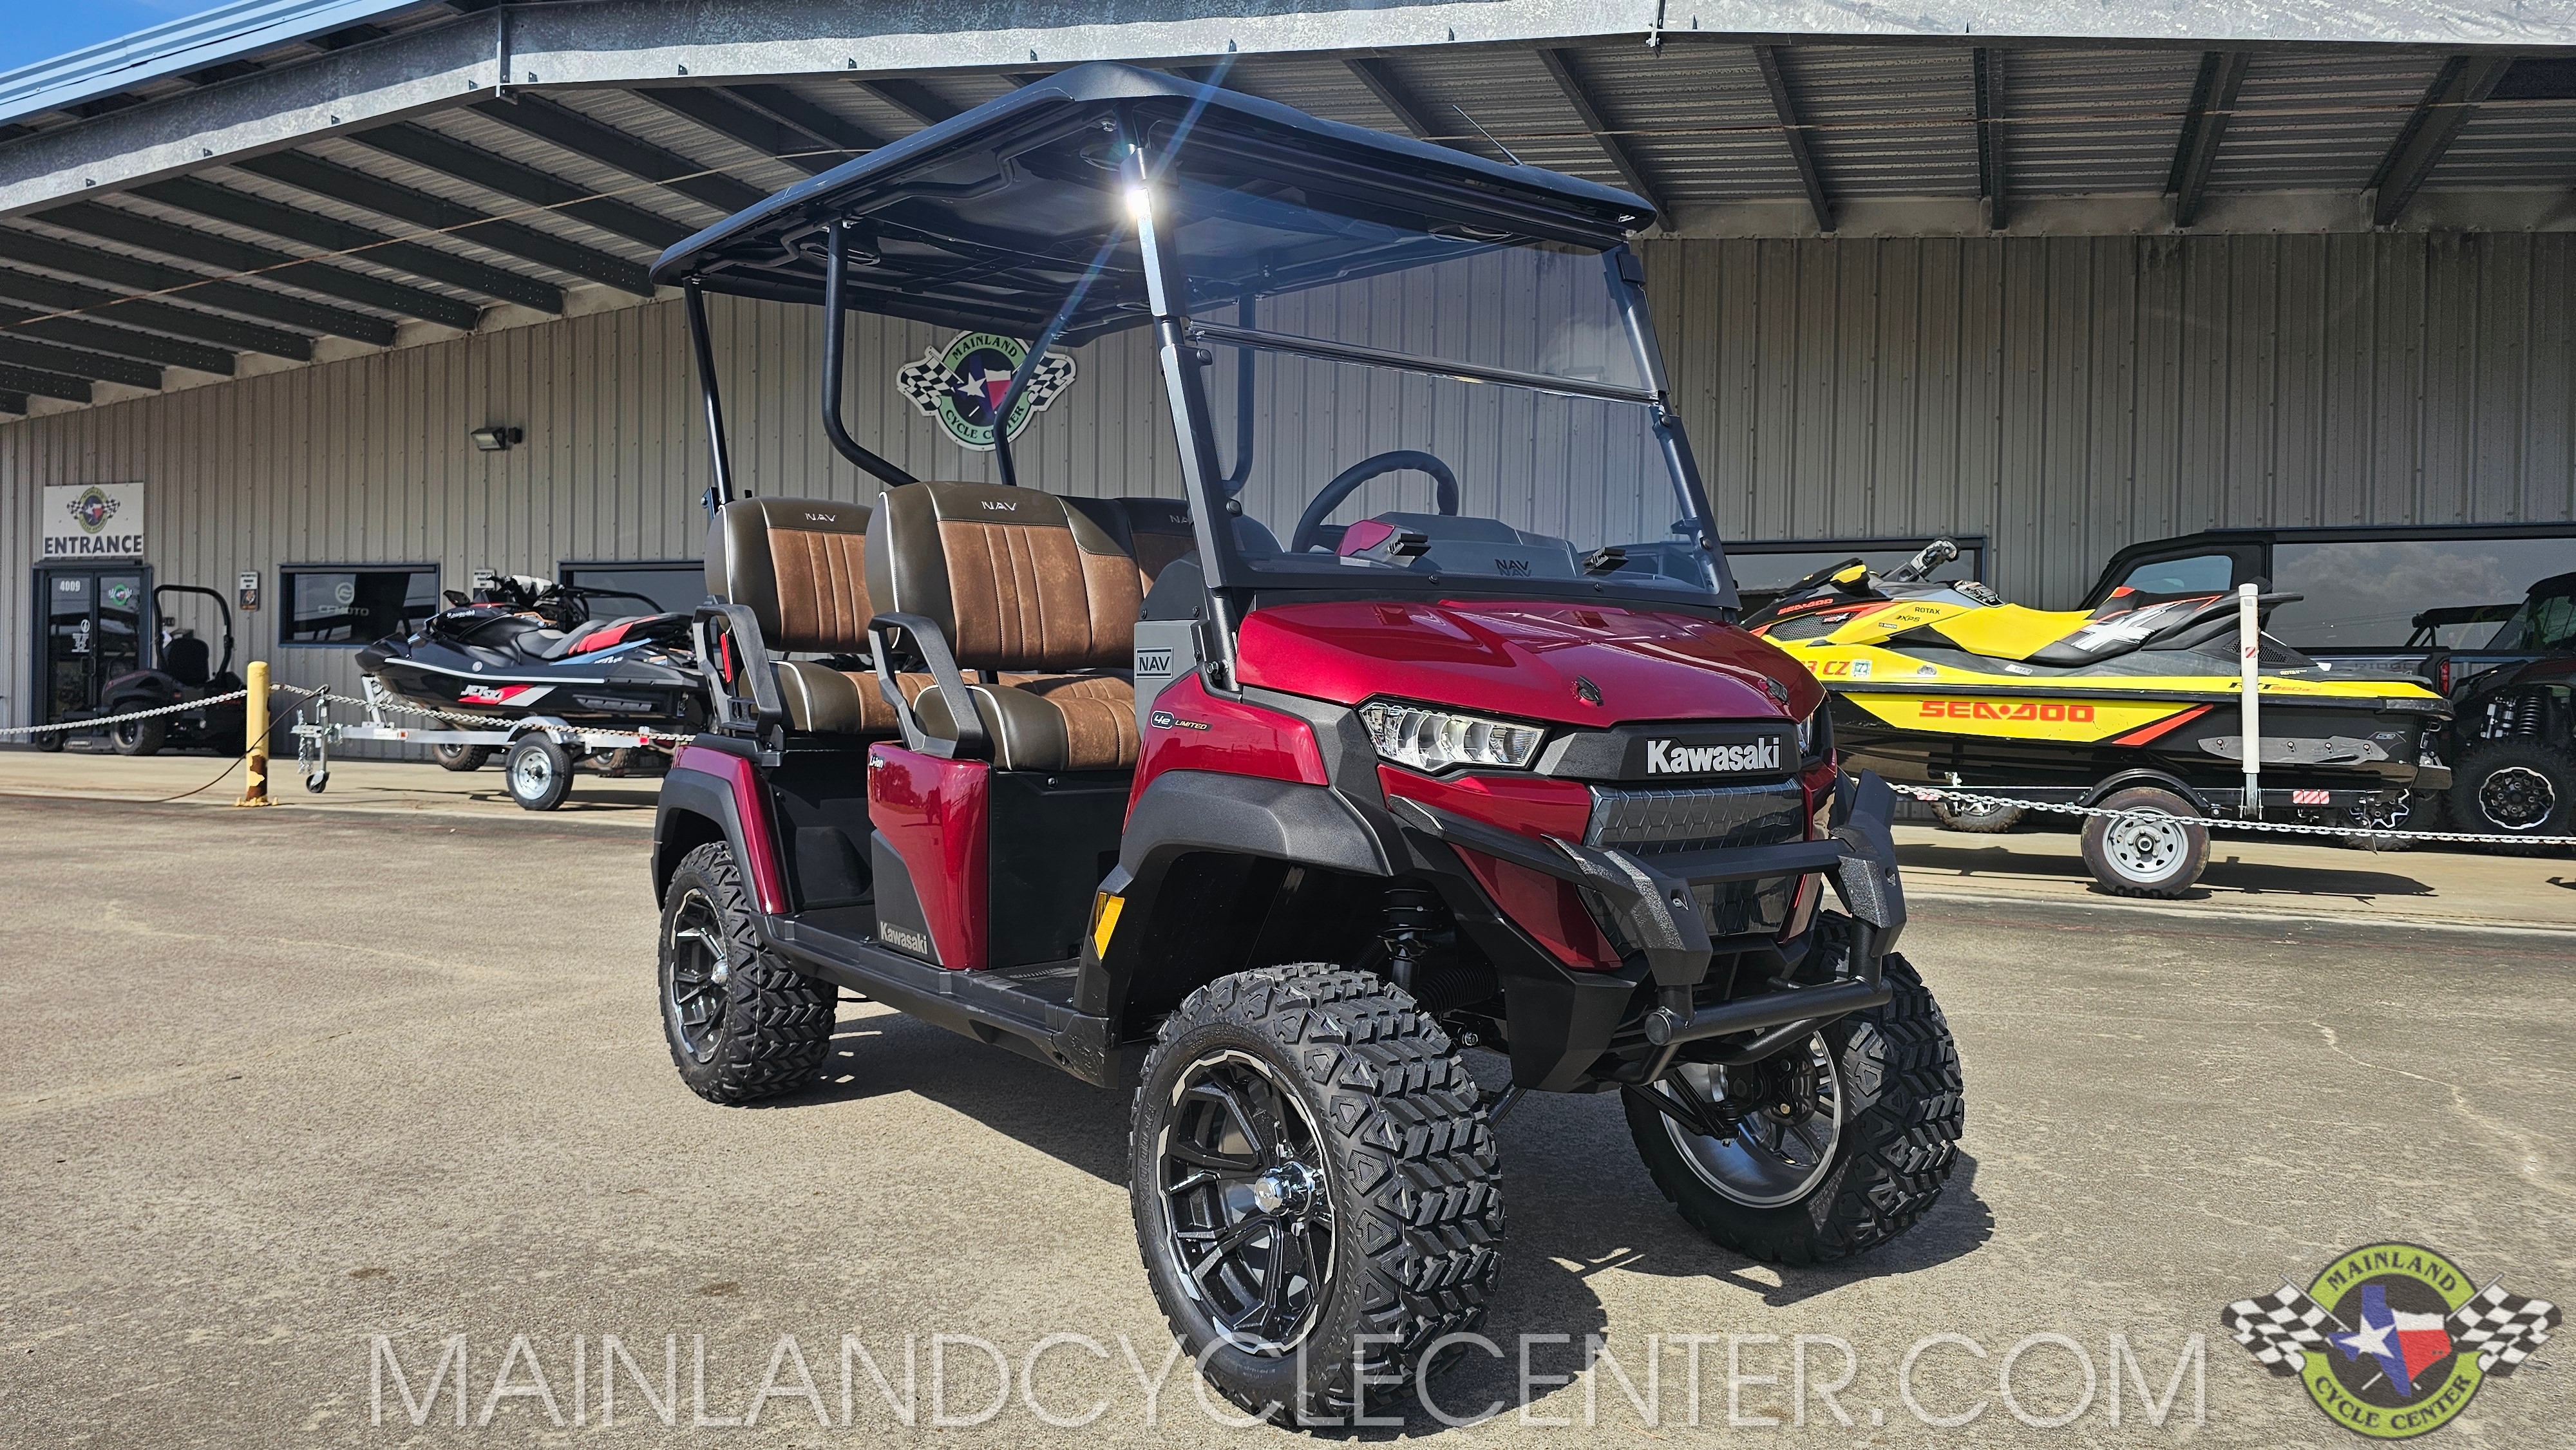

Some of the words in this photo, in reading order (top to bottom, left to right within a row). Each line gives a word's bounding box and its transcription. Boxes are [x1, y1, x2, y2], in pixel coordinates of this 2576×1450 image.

[952, 335, 1018, 360] MAINLAND
[945, 410, 978, 438] CYCLE
[981, 501, 1016, 511] NAV
[805, 513, 835, 522] NAV
[1169, 515, 1189, 523] NA
[44, 535, 143, 554] ENTRANCE
[1495, 559, 1529, 570] NAV
[60, 580, 80, 592] 4009
[1139, 656, 1170, 671] NAV
[1823, 661, 1850, 675] CZ
[1154, 715, 1171, 725] 4e
[1175, 719, 1208, 730] LIMITED
[1647, 737, 1779, 773] Kawasaki
[880, 921, 927, 954] Kawasaki
